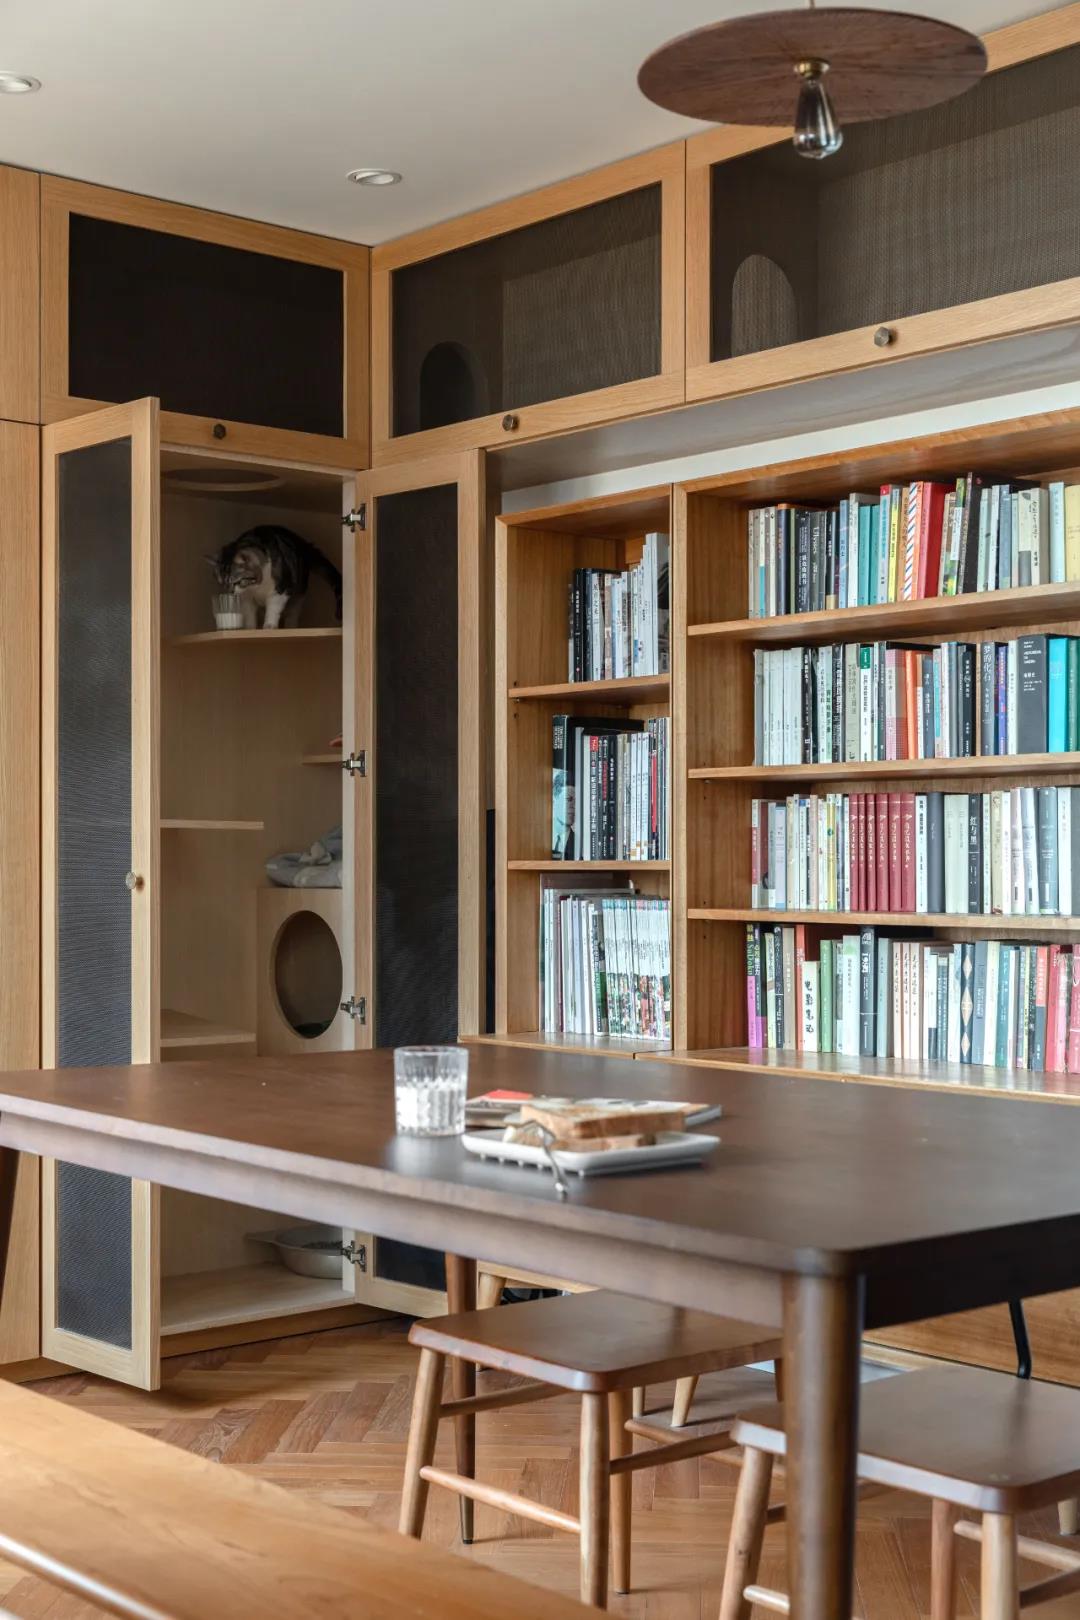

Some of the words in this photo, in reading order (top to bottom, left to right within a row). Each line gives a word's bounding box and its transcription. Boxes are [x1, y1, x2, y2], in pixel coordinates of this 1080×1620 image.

[969, 816, 977, 845] 红与黑
[861, 952, 869, 973] 1984
